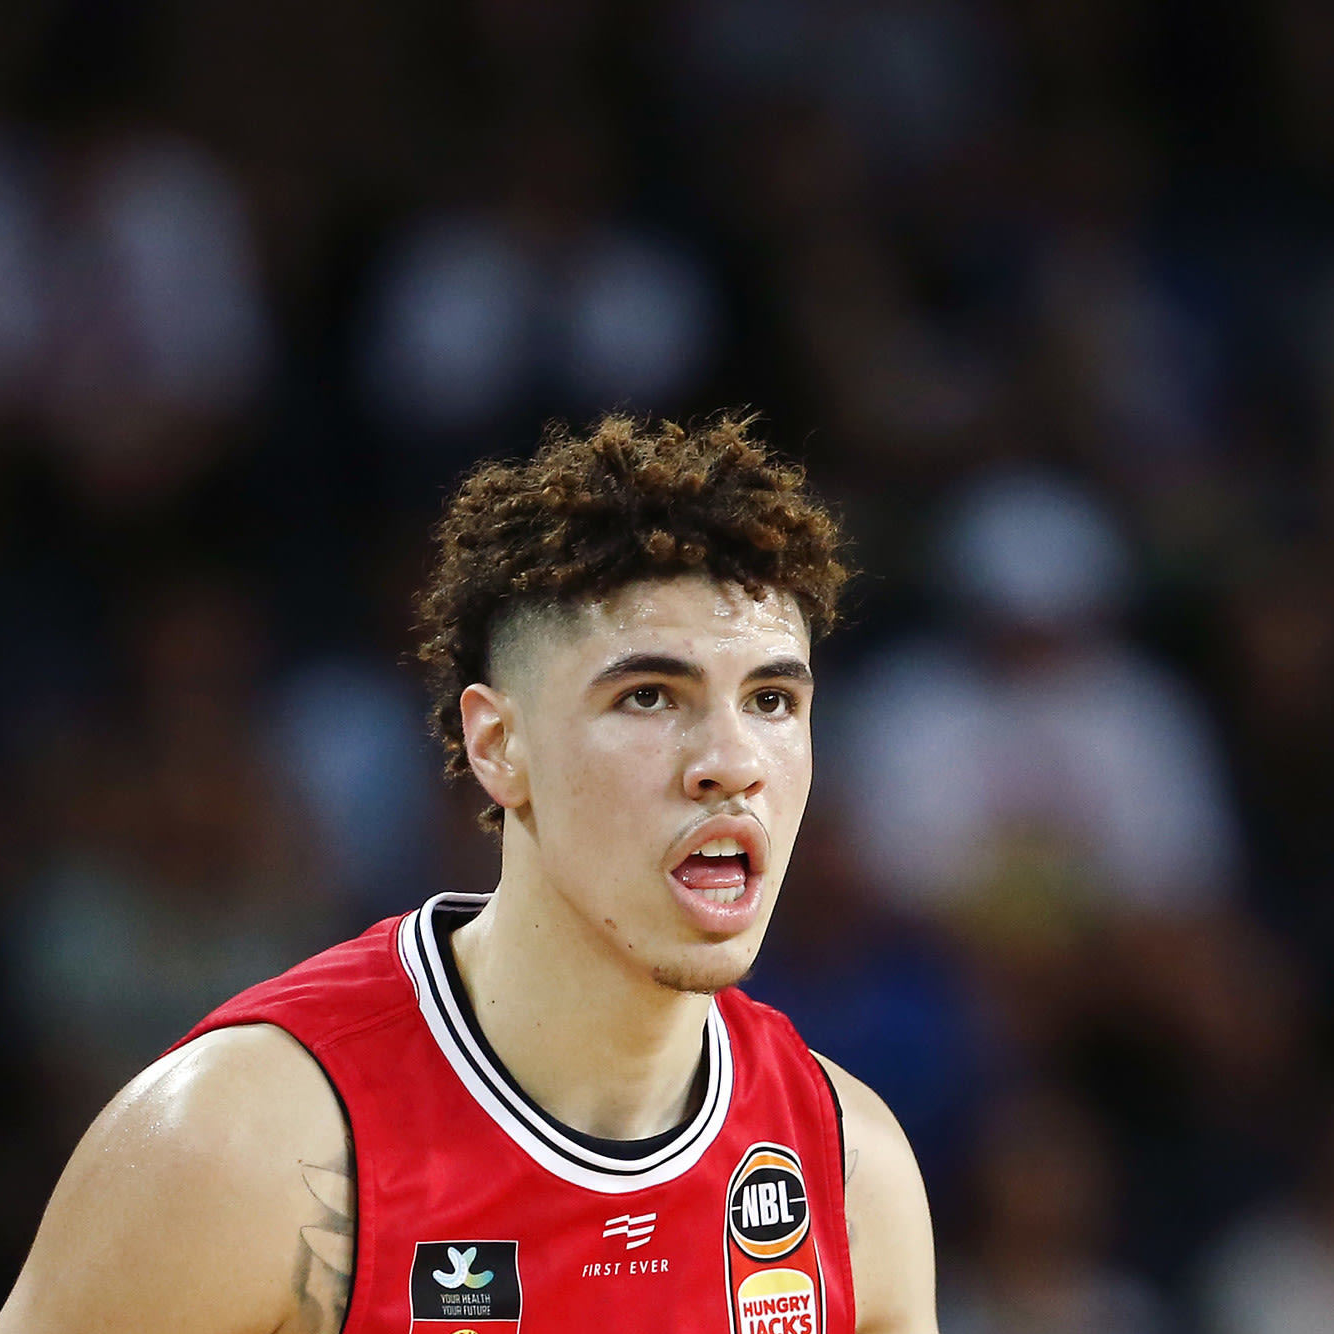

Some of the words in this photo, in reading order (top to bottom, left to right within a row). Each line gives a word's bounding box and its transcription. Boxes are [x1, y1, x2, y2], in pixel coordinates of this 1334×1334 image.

[741, 1180, 795, 1229] NBL
[581, 1262, 622, 1278] FIRST
[629, 1258, 670, 1275] EVER
[439, 1293, 461, 1304] YOUR
[461, 1293, 492, 1304] HEALTH
[743, 1294, 811, 1318] HUNGRY
[441, 1305, 463, 1316] YOUR
[463, 1305, 492, 1316] FUTURE
